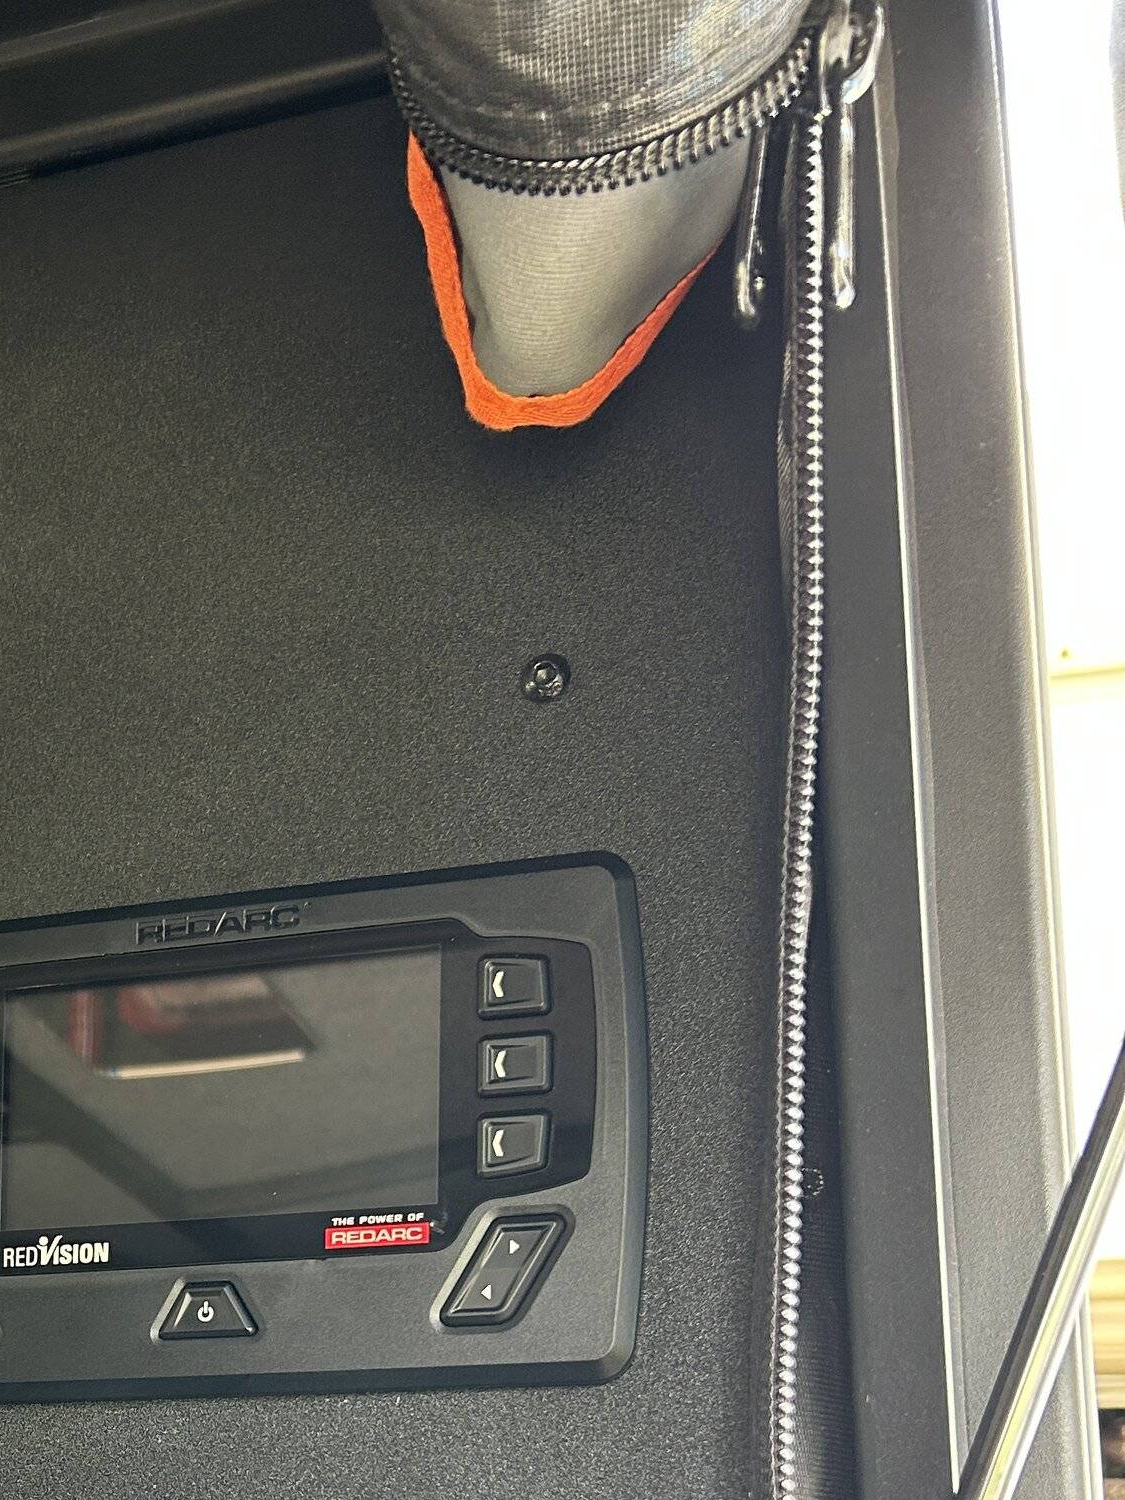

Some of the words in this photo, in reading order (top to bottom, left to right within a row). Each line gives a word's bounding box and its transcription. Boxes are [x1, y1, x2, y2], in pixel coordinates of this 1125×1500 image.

[136, 904, 300, 945] REDARC
[331, 1217, 355, 1227] THE
[359, 1213, 403, 1225] POWER
[407, 1212, 425, 1222] OF
[331, 1227, 423, 1245] REDARC
[3, 1234, 110, 1268] REDVISION
